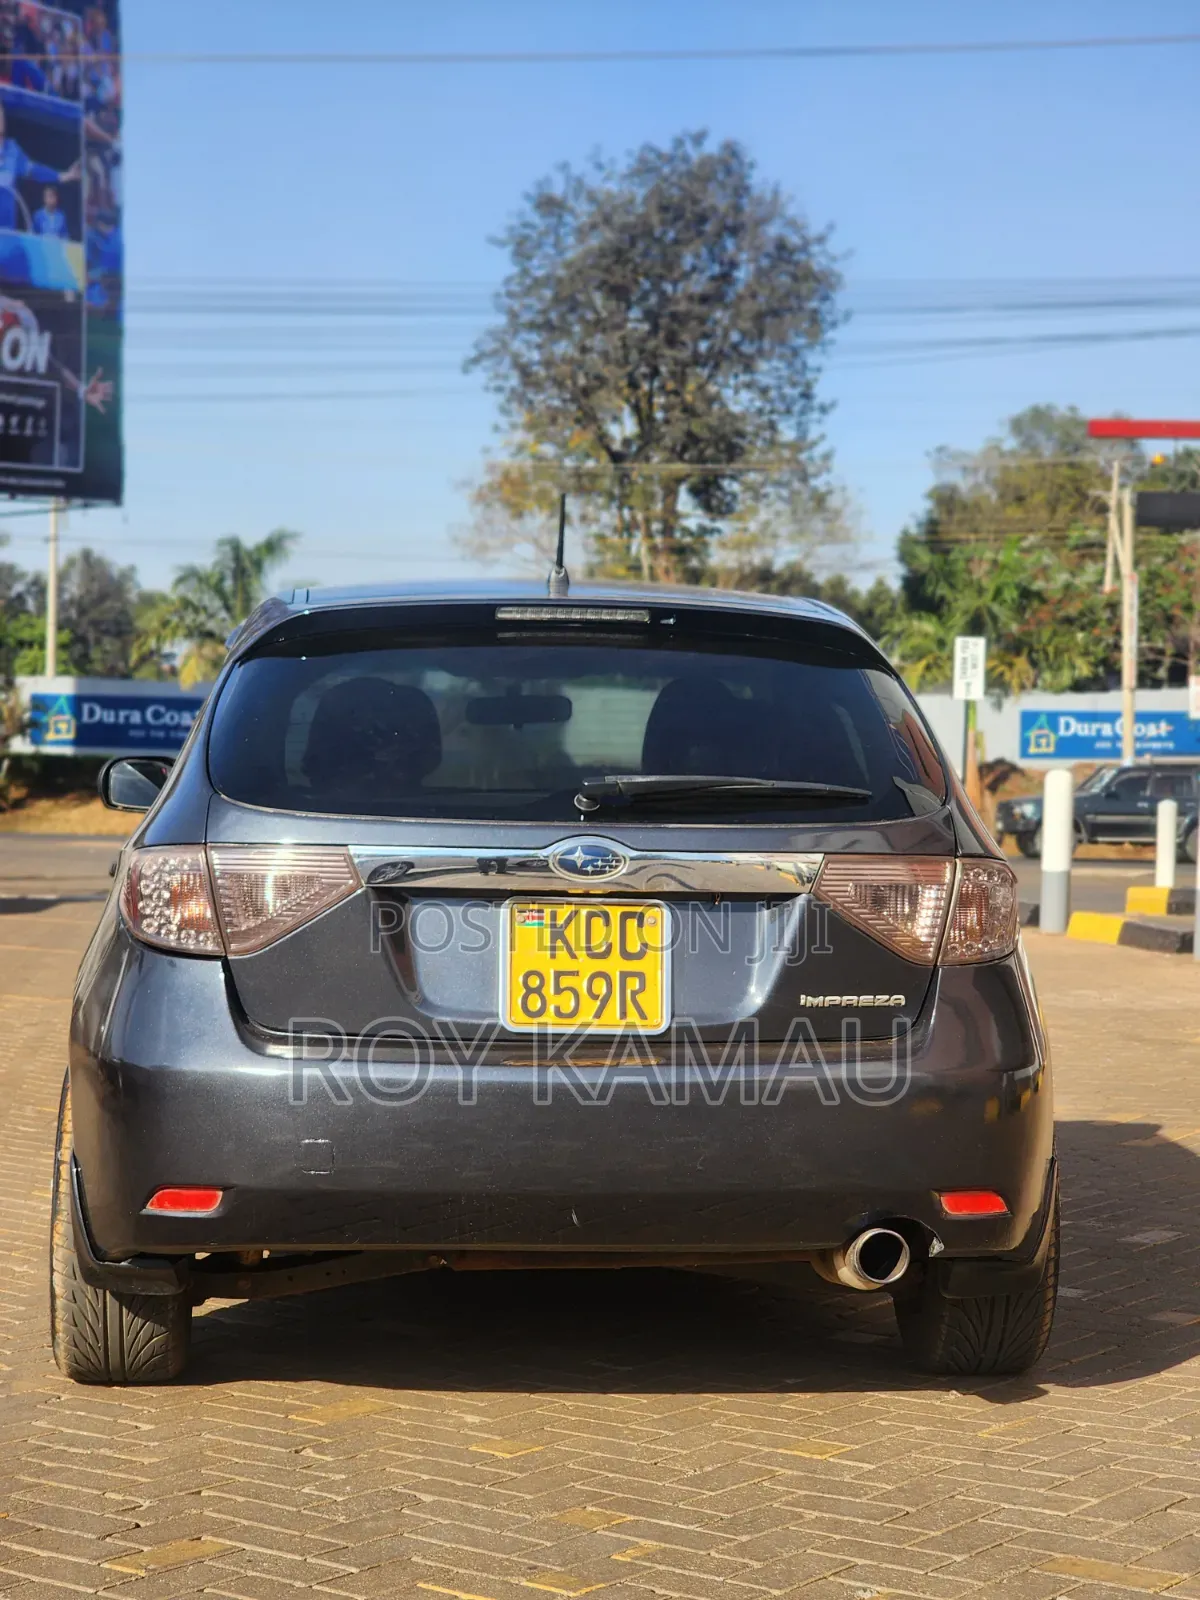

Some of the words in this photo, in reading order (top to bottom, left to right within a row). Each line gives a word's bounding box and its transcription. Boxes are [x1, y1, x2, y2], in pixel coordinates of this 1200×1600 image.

[549, 909, 649, 960] KCC
[520, 969, 648, 1021] 859R
[799, 994, 906, 1008] IMPREZA
